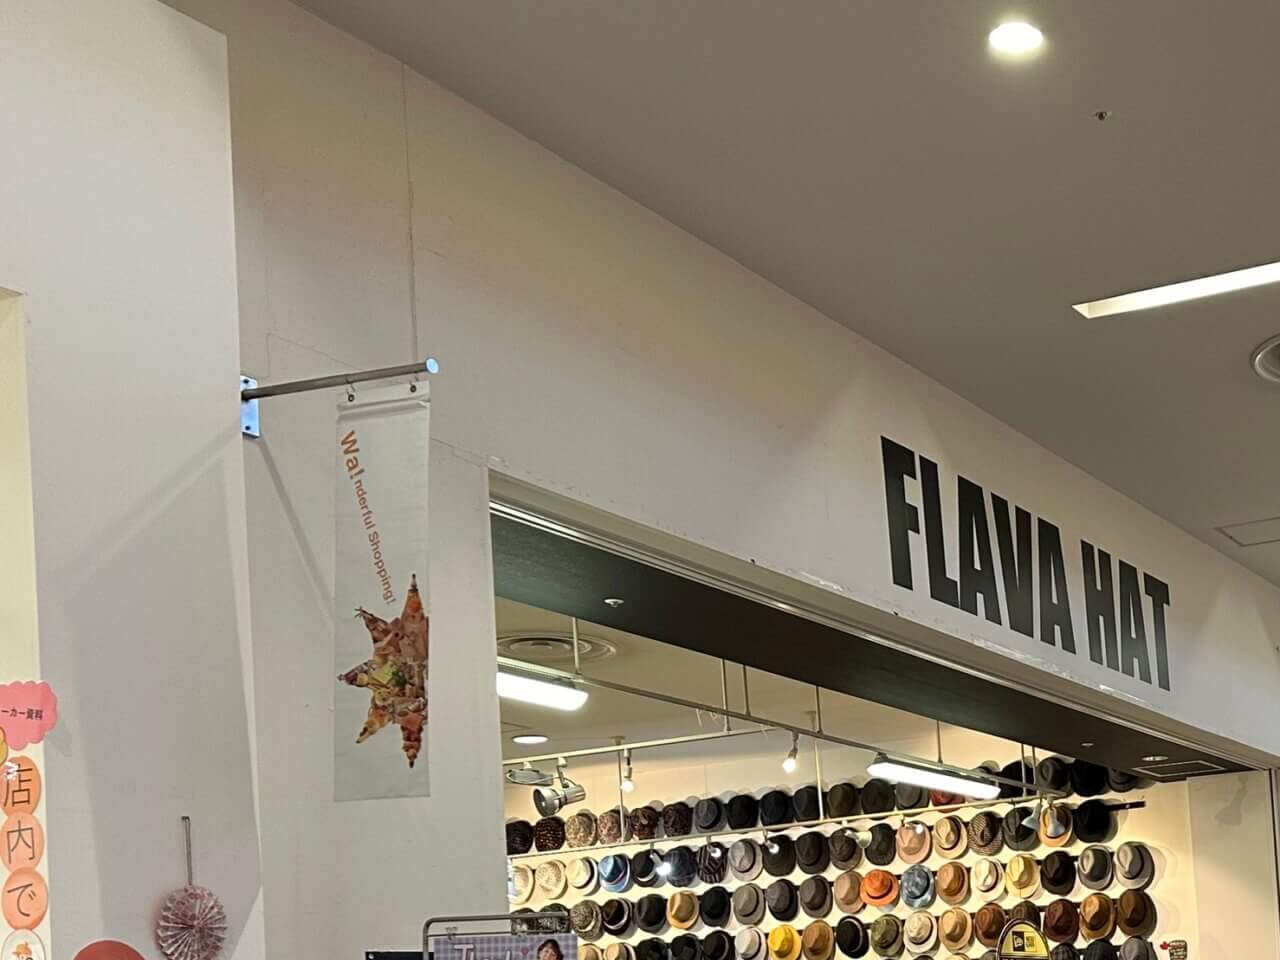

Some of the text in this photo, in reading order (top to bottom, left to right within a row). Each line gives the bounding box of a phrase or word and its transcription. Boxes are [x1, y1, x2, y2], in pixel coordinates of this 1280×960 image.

[368, 530, 397, 606] Shopping!
[880, 434, 1171, 692] FLAVA HAT
